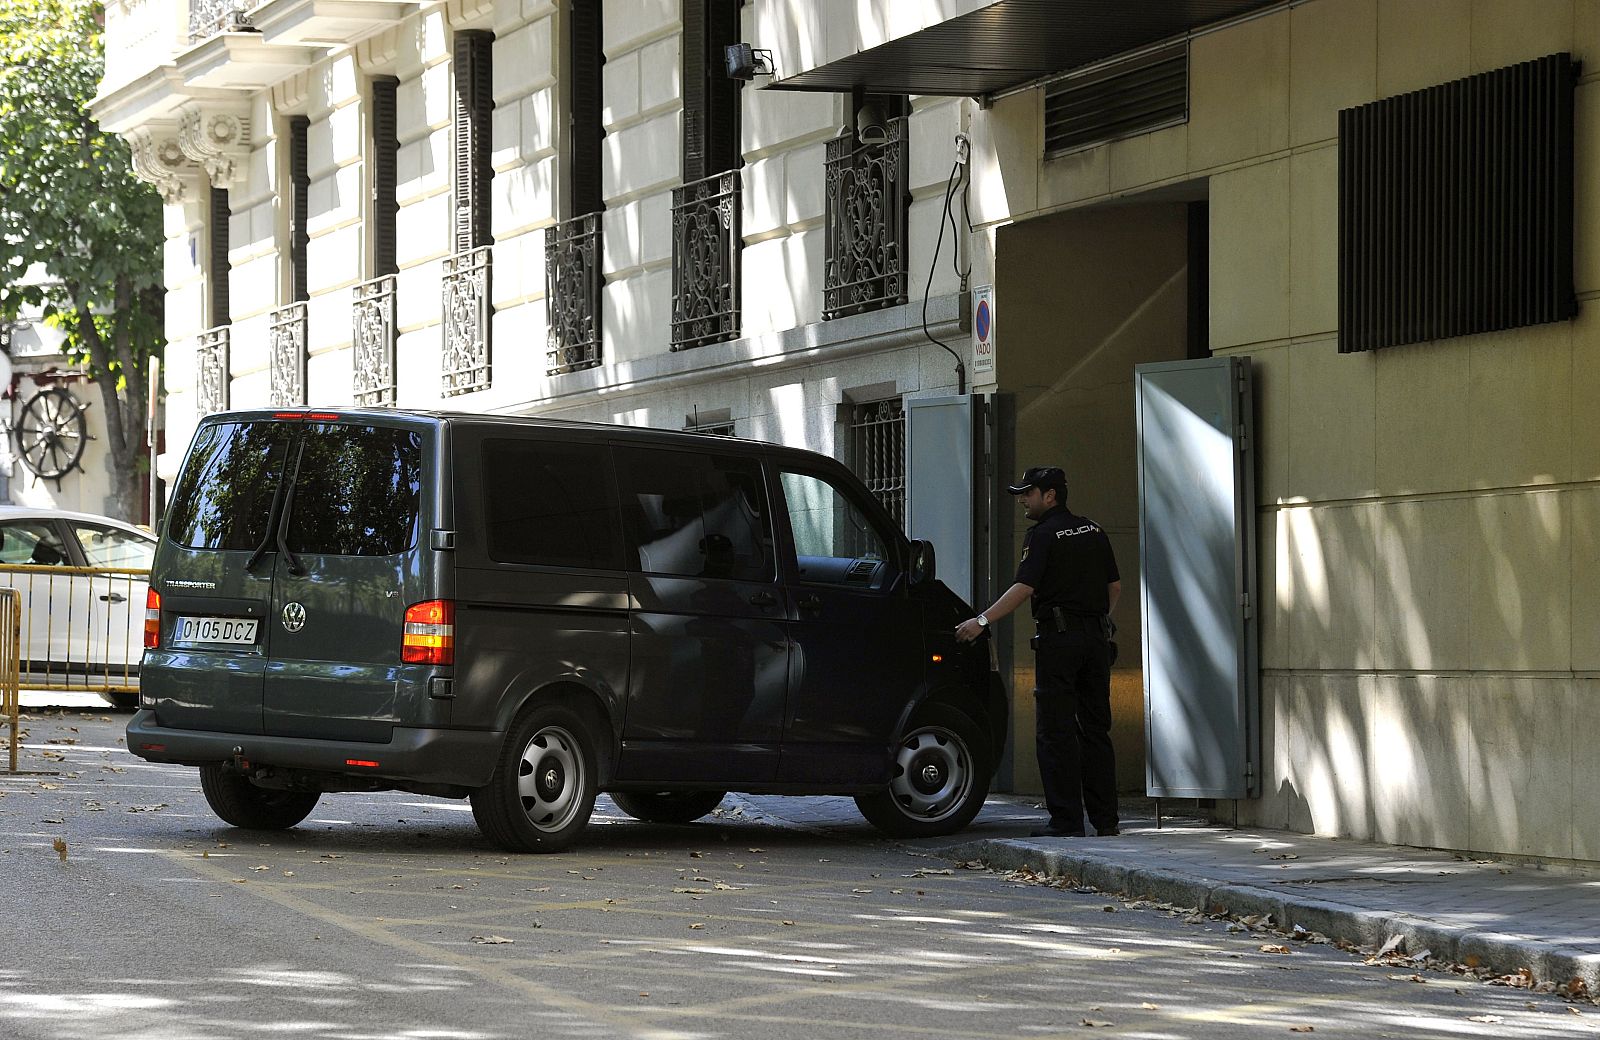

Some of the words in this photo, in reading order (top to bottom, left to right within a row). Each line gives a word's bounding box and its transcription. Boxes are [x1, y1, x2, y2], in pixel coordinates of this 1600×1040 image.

[975, 342, 991, 356] VADO
[1055, 524, 1099, 539] POLICIA
[165, 580, 216, 590] TRANSPORTER
[183, 620, 220, 640] 0105
[222, 621, 255, 641] DCZ
